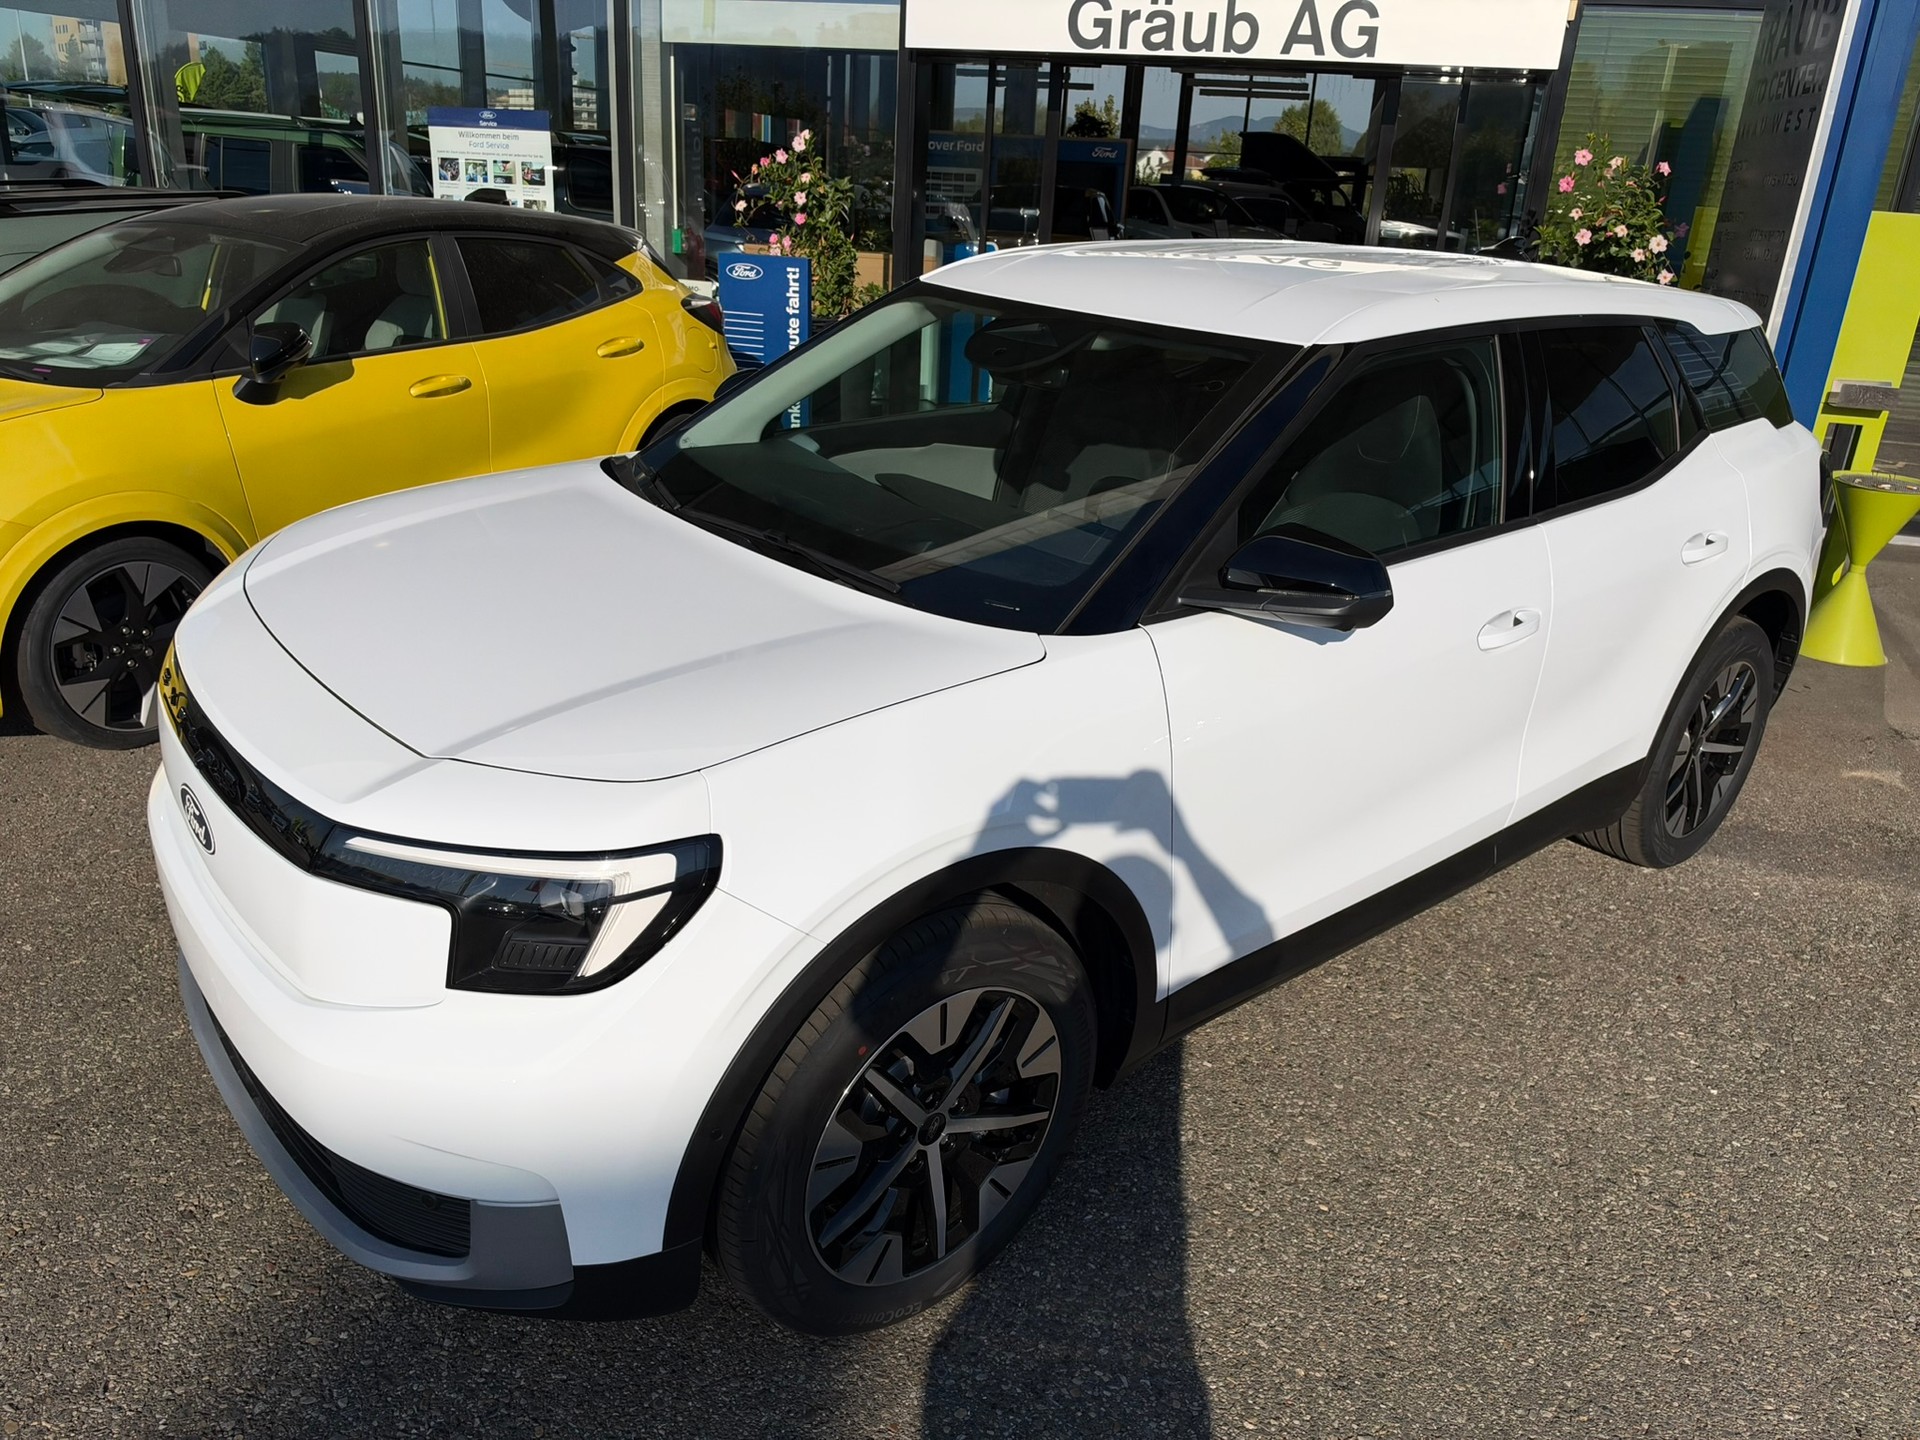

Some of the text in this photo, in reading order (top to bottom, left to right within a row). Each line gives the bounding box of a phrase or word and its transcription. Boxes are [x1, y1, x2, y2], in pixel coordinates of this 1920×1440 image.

[1067, 0, 1380, 58] Gräub AG
[479, 120, 498, 128] Service
[458, 131, 520, 141] Willkommen beim
[469, 141, 510, 150] Ford Service
[957, 140, 984, 152] Ford
[1091, 146, 1117, 158] Ford
[731, 264, 758, 279] Ford
[785, 266, 800, 315] fahrt!
[183, 790, 209, 849] Ford
